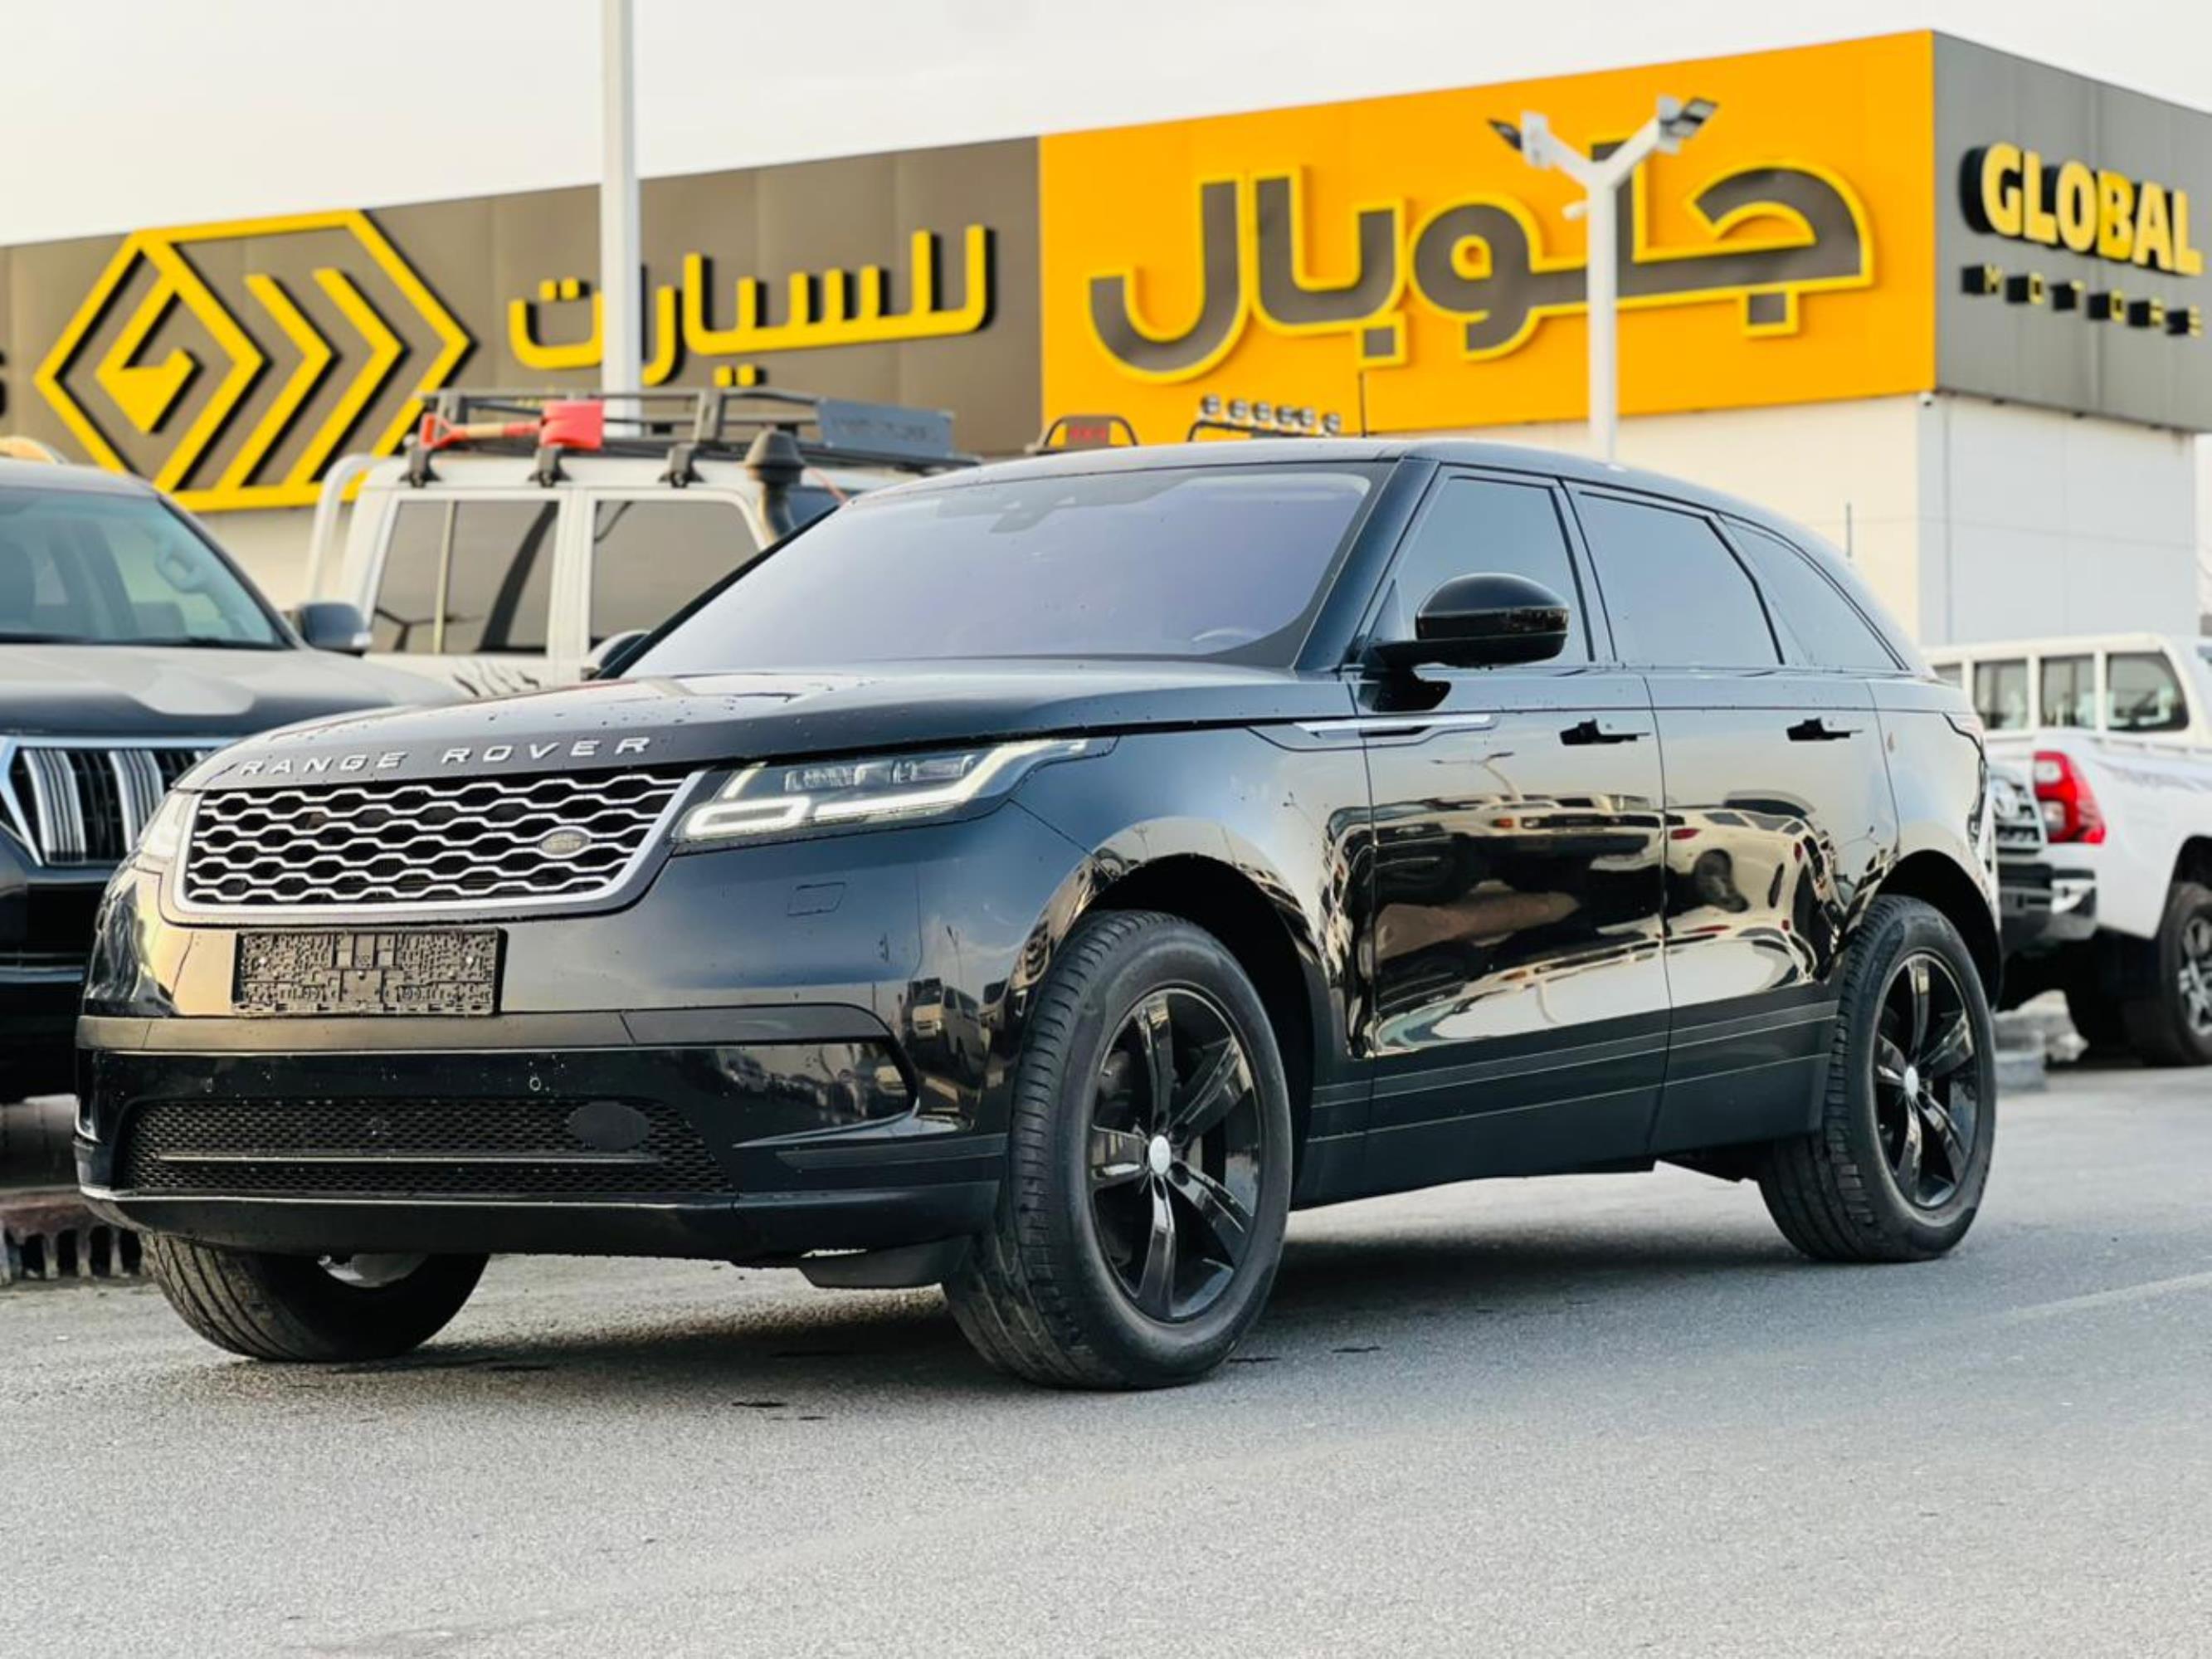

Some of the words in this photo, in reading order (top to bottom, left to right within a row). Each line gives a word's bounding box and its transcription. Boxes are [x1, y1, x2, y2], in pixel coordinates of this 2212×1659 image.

[1087, 139, 1873, 382] جلوبال
[1980, 141, 2205, 277] GLOBAL
[240, 750, 408, 776] RANGE
[441, 736, 651, 764] ROVER
